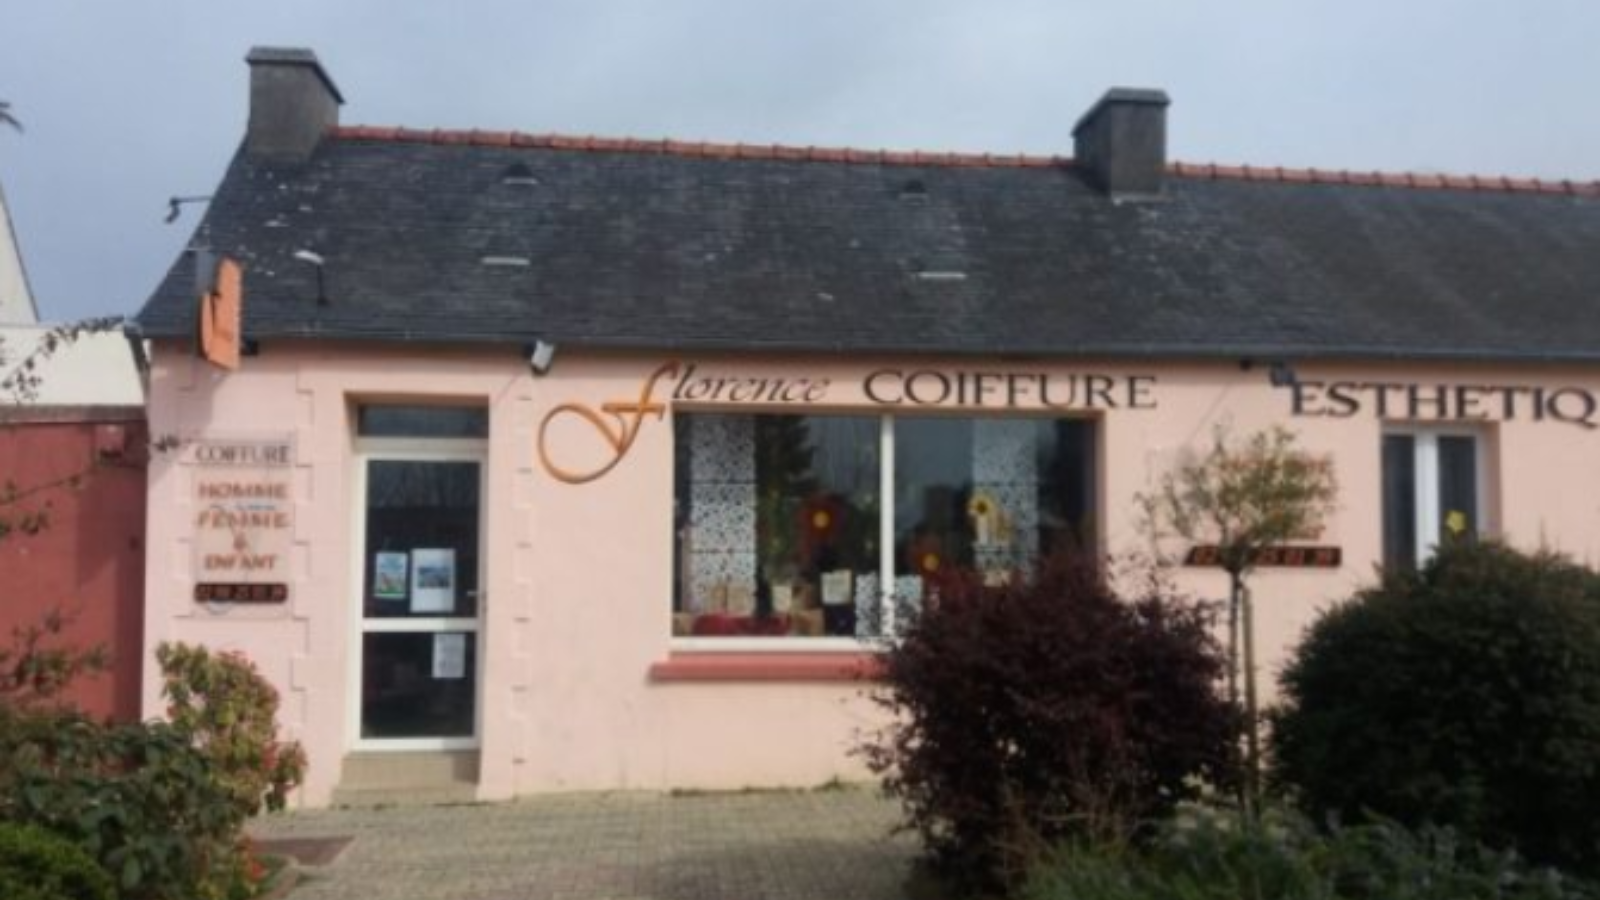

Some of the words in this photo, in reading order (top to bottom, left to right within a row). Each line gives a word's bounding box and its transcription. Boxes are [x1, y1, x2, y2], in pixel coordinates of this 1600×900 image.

[862, 368, 1158, 409] COIFFURE
[1289, 380, 1599, 429] ESTHETIQ
[195, 444, 290, 463] COIFFURE
[198, 482, 288, 499] HOMME
[197, 512, 289, 528] FEMME
[205, 554, 277, 570] ENFANT
